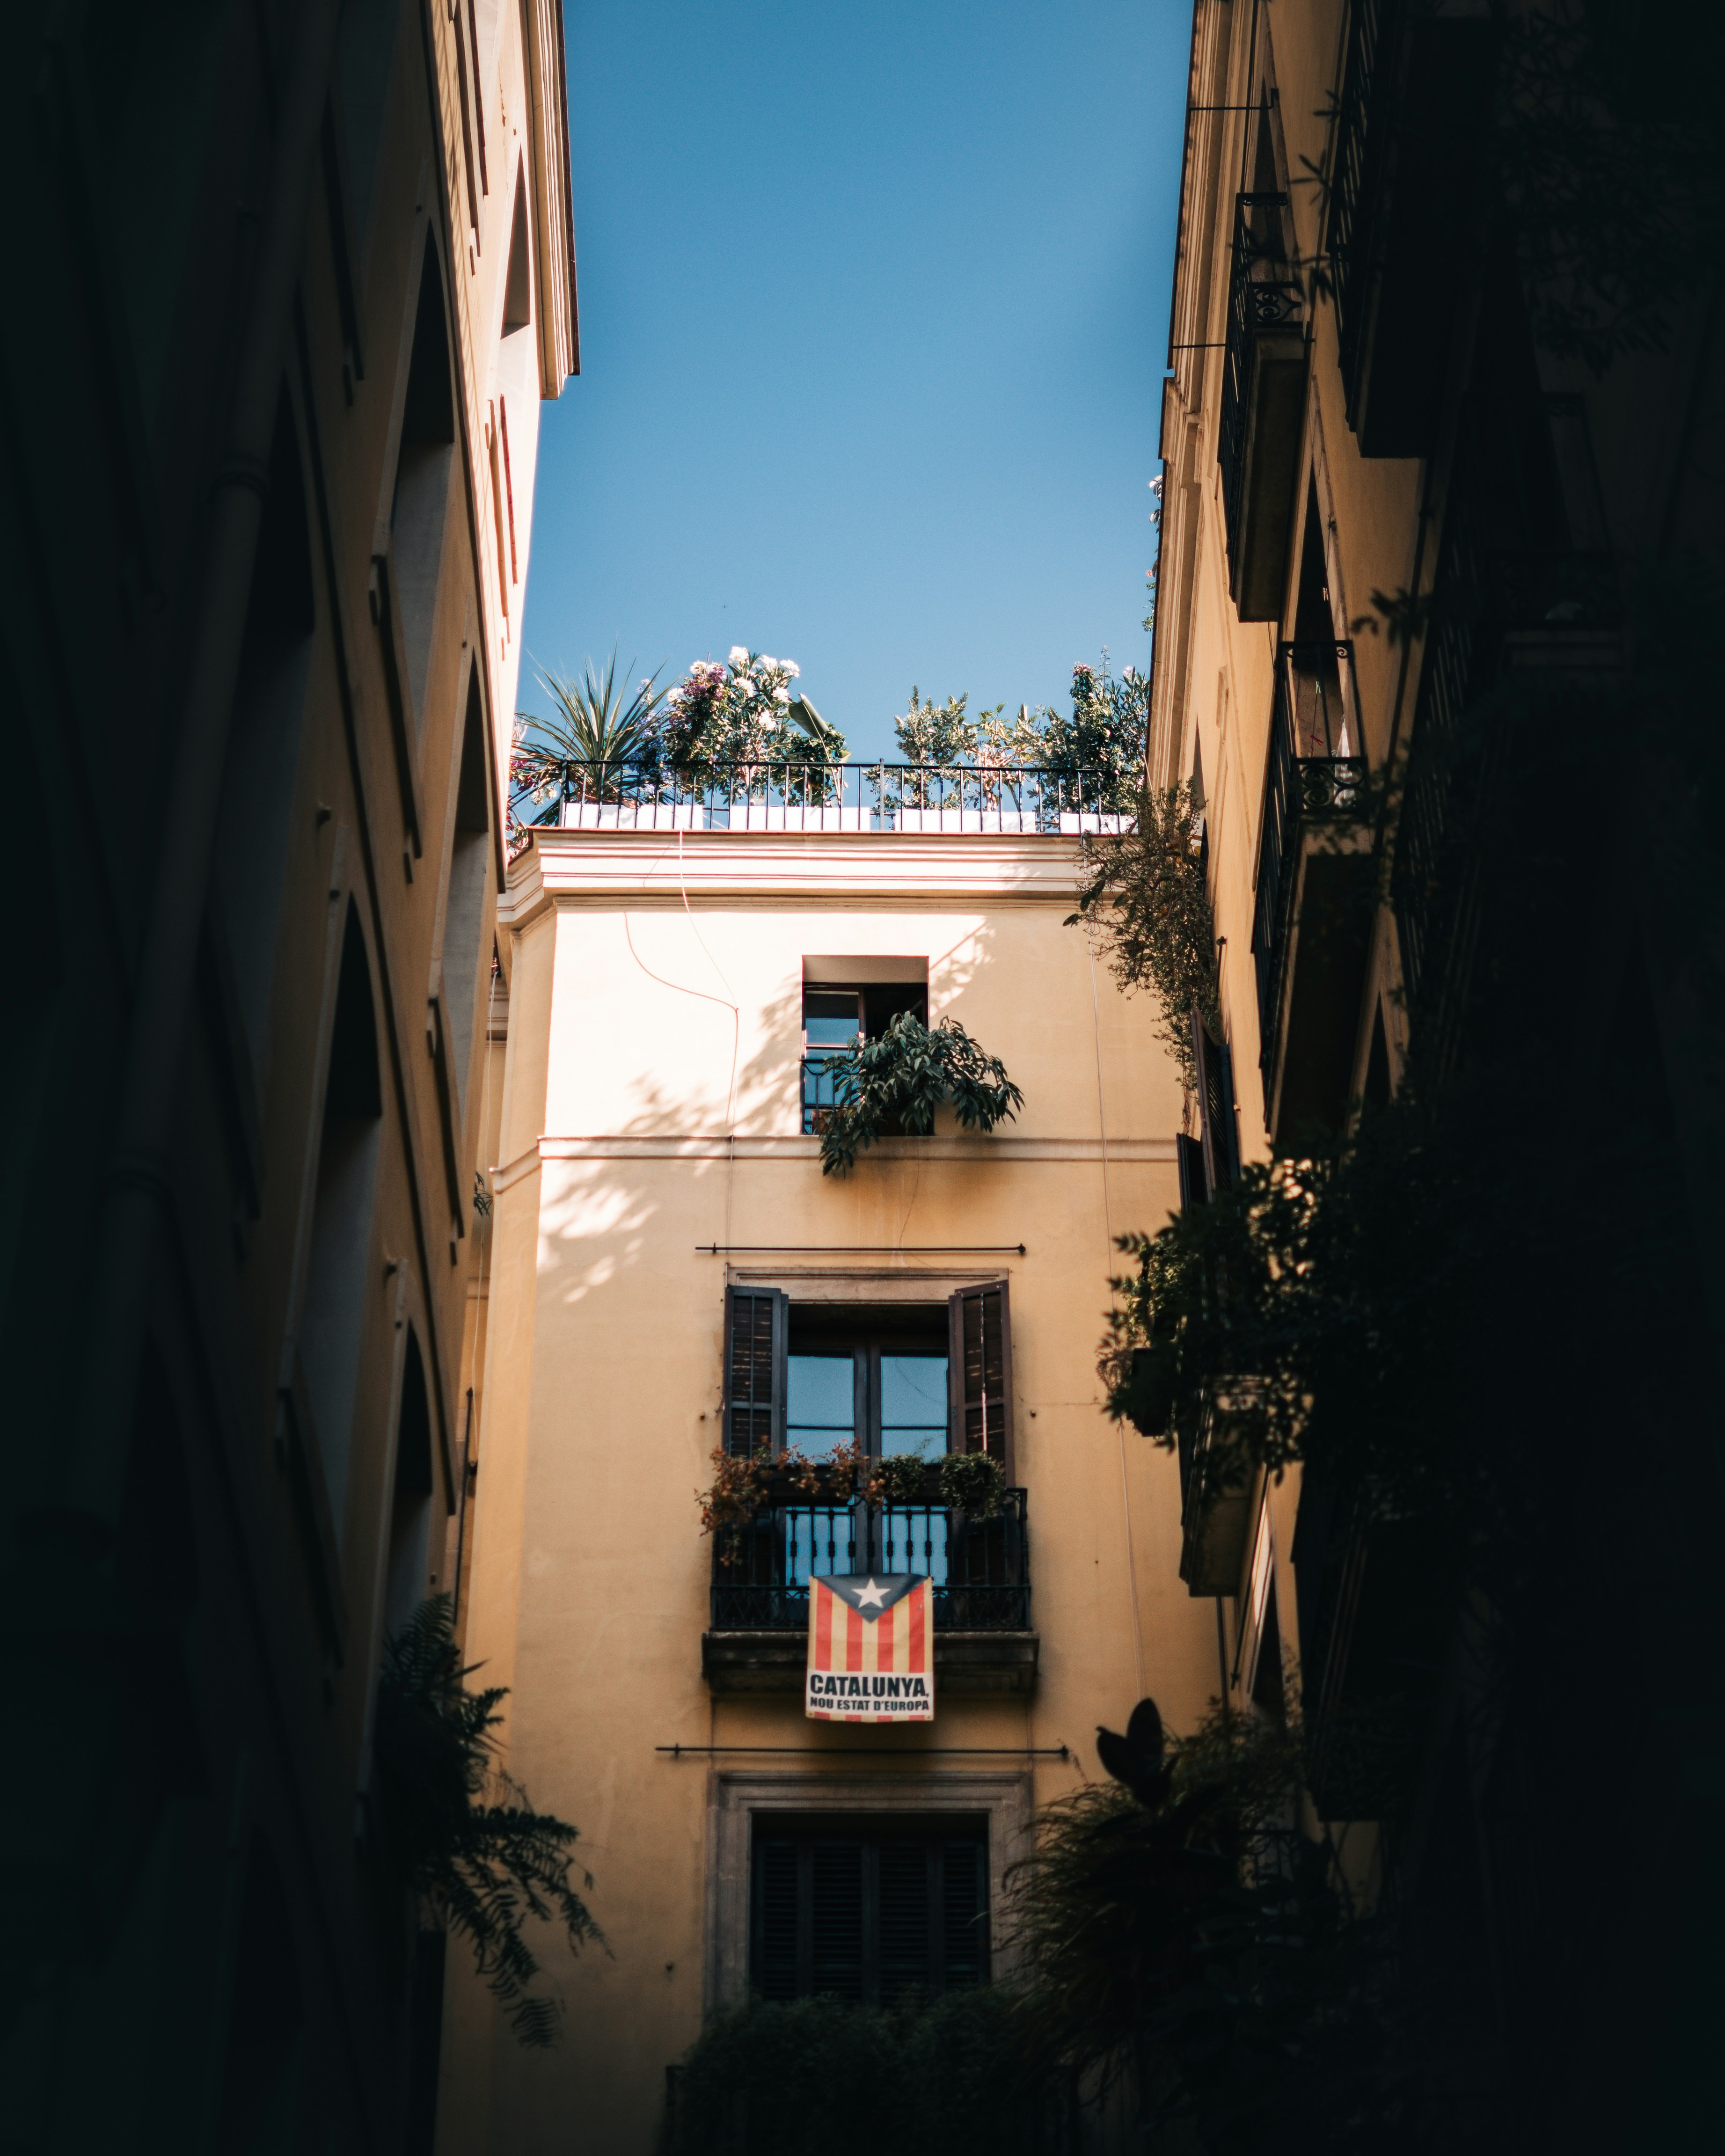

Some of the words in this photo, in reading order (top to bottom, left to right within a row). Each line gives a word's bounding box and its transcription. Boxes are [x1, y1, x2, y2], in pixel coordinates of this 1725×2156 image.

[810, 1674, 929, 1697] CATALUNYA,
[811, 1697, 833, 1709] NOU
[837, 1700, 870, 1710] ESTAT
[874, 1700, 929, 1711] D'EUROPA
